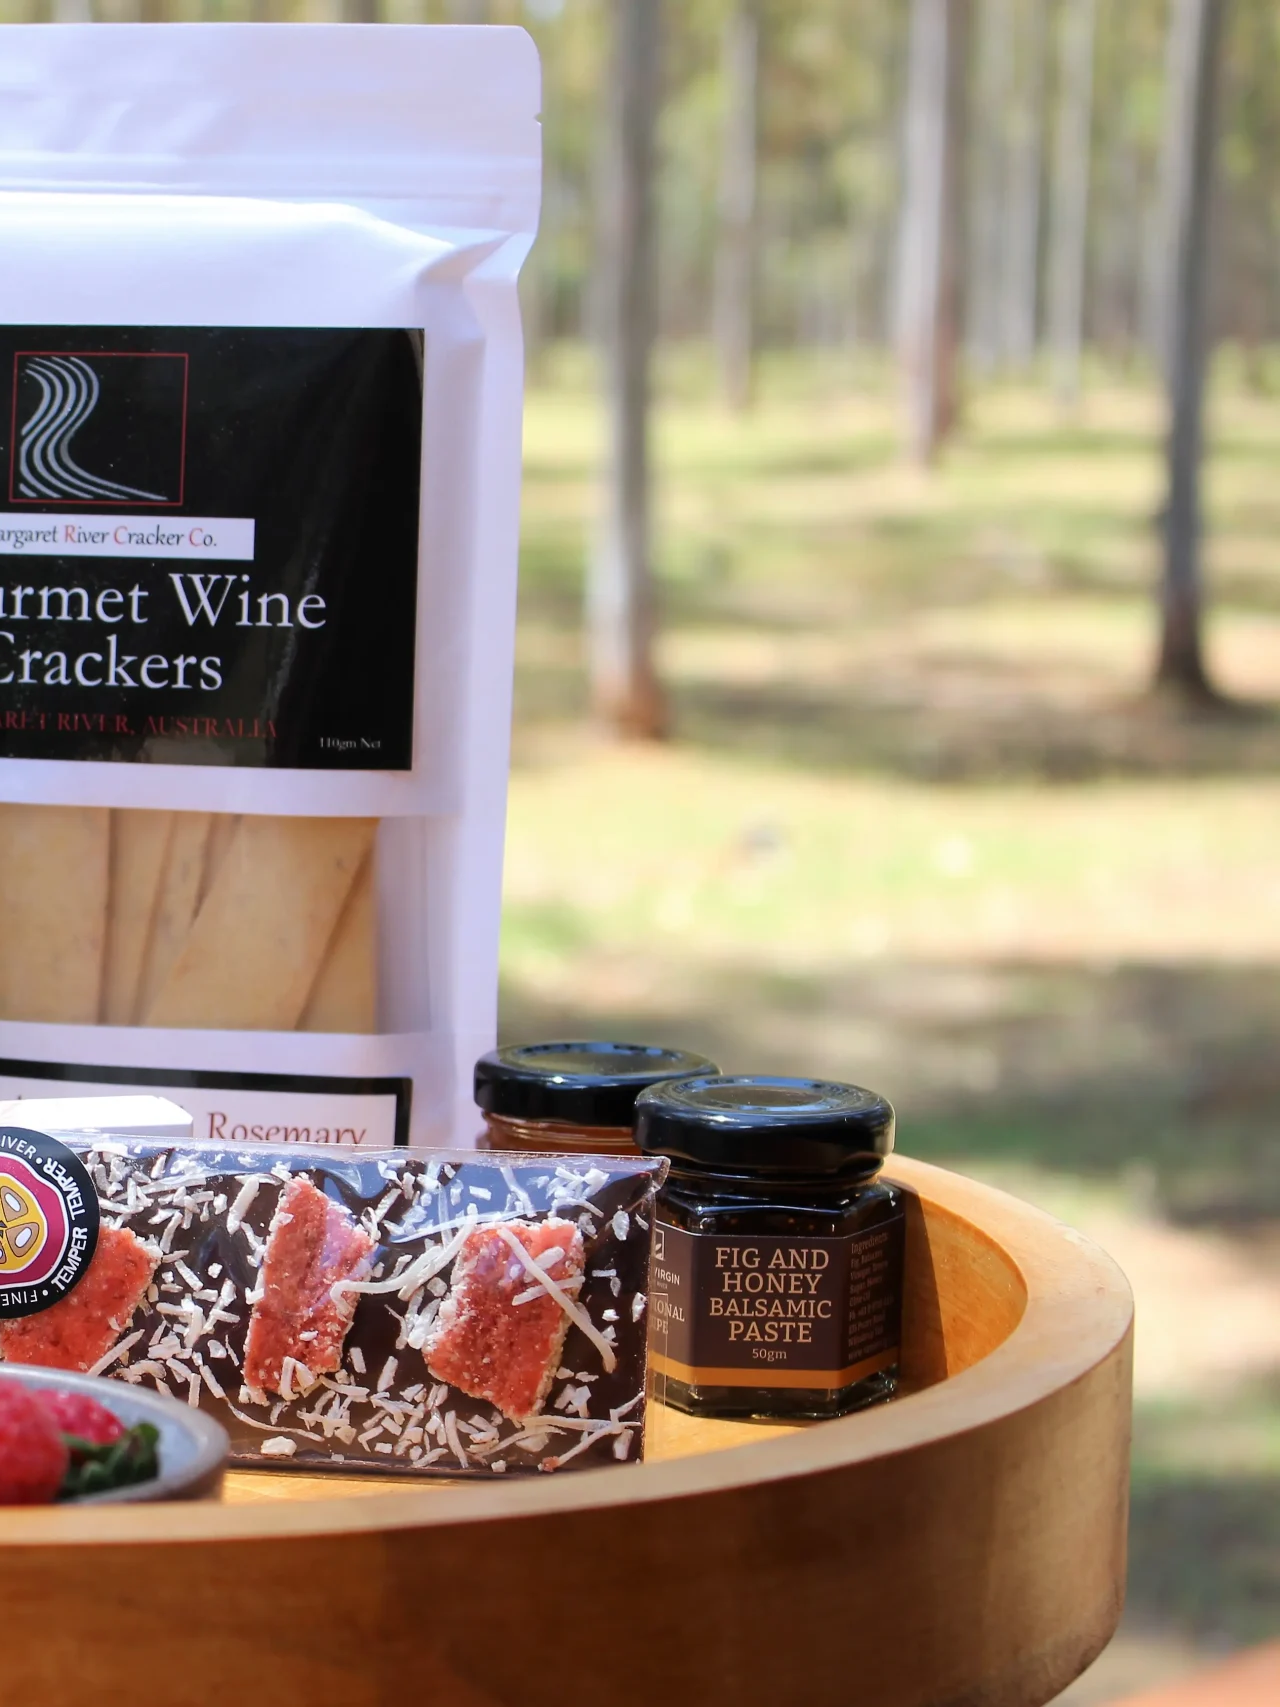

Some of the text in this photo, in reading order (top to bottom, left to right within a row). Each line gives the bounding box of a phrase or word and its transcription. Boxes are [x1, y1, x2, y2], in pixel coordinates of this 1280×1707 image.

[63, 524, 110, 545] River
[114, 525, 185, 546] Cracker
[188, 528, 218, 547] Co.
[168, 573, 327, 629] Wine
[57, 712, 135, 736] RIVER,
[144, 715, 278, 739] AUSTRALIA
[360, 737, 382, 749] Net
[207, 1111, 367, 1145] Rosemary
[42, 1156, 88, 1292] TEMPER TEMPER
[715, 1247, 830, 1270] FIG AND
[722, 1271, 823, 1295] HONEY
[0, 1289, 38, 1307] FINE
[709, 1297, 832, 1319] BALSAMIC
[728, 1320, 813, 1343] PASTE
[751, 1348, 787, 1362] 50gm
